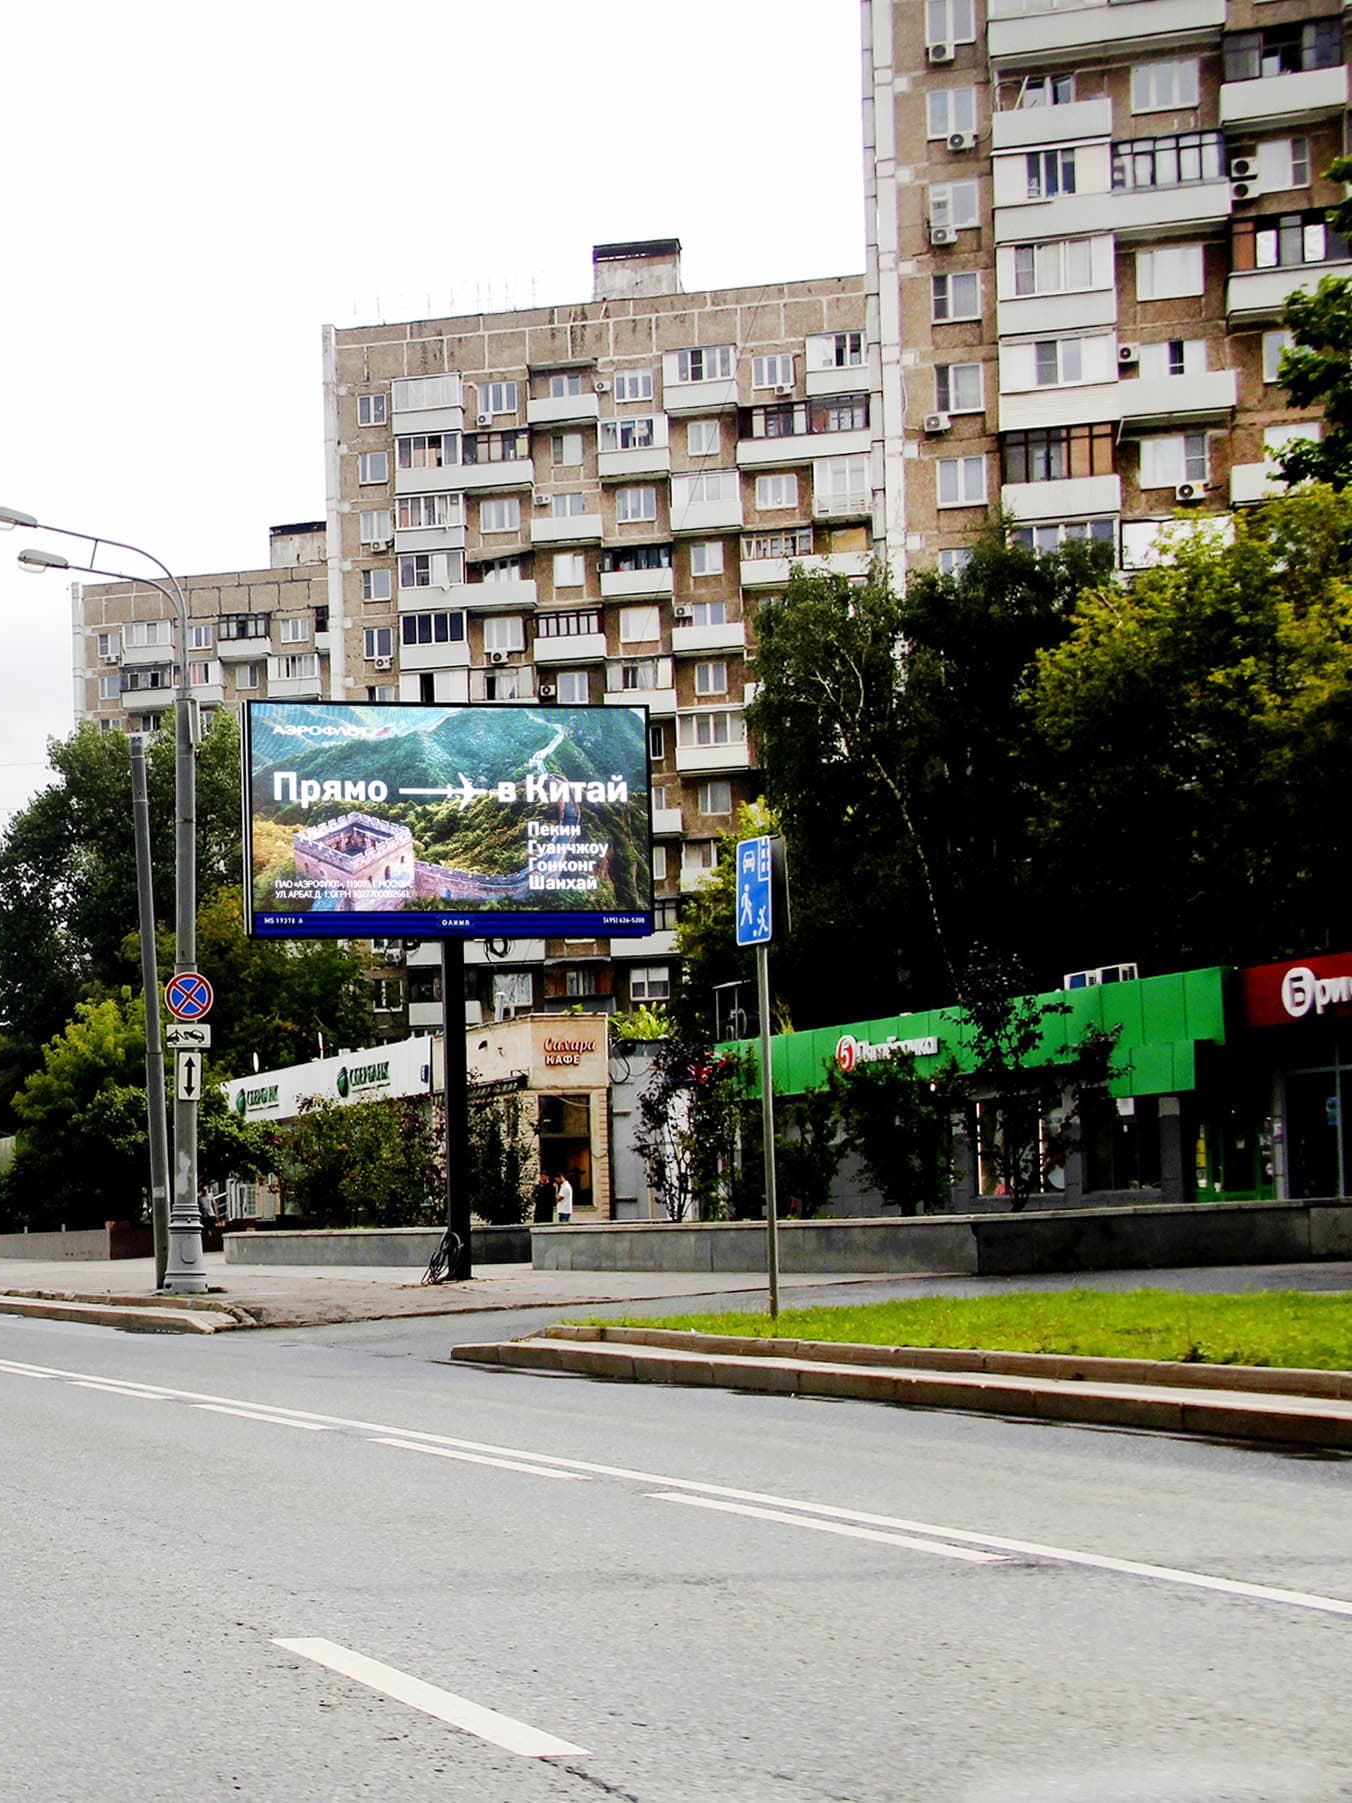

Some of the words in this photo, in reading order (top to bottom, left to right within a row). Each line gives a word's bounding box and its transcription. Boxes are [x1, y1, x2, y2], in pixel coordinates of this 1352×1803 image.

[272, 725, 369, 737] АЭРОФЛОТ
[273, 771, 388, 809] Прямо
[498, 781, 517, 803] в
[526, 774, 628, 804] Китай
[528, 821, 581, 836] Пекин
[528, 840, 609, 857] Гуанчжоу
[528, 858, 597, 872] Гонконг
[275, 880, 293, 888] ПАО
[529, 874, 598, 890] Шанхай
[1282, 967, 1352, 1015] Бри
[544, 1038, 596, 1054] Сахара
[545, 1055, 581, 1067] КАФЕ
